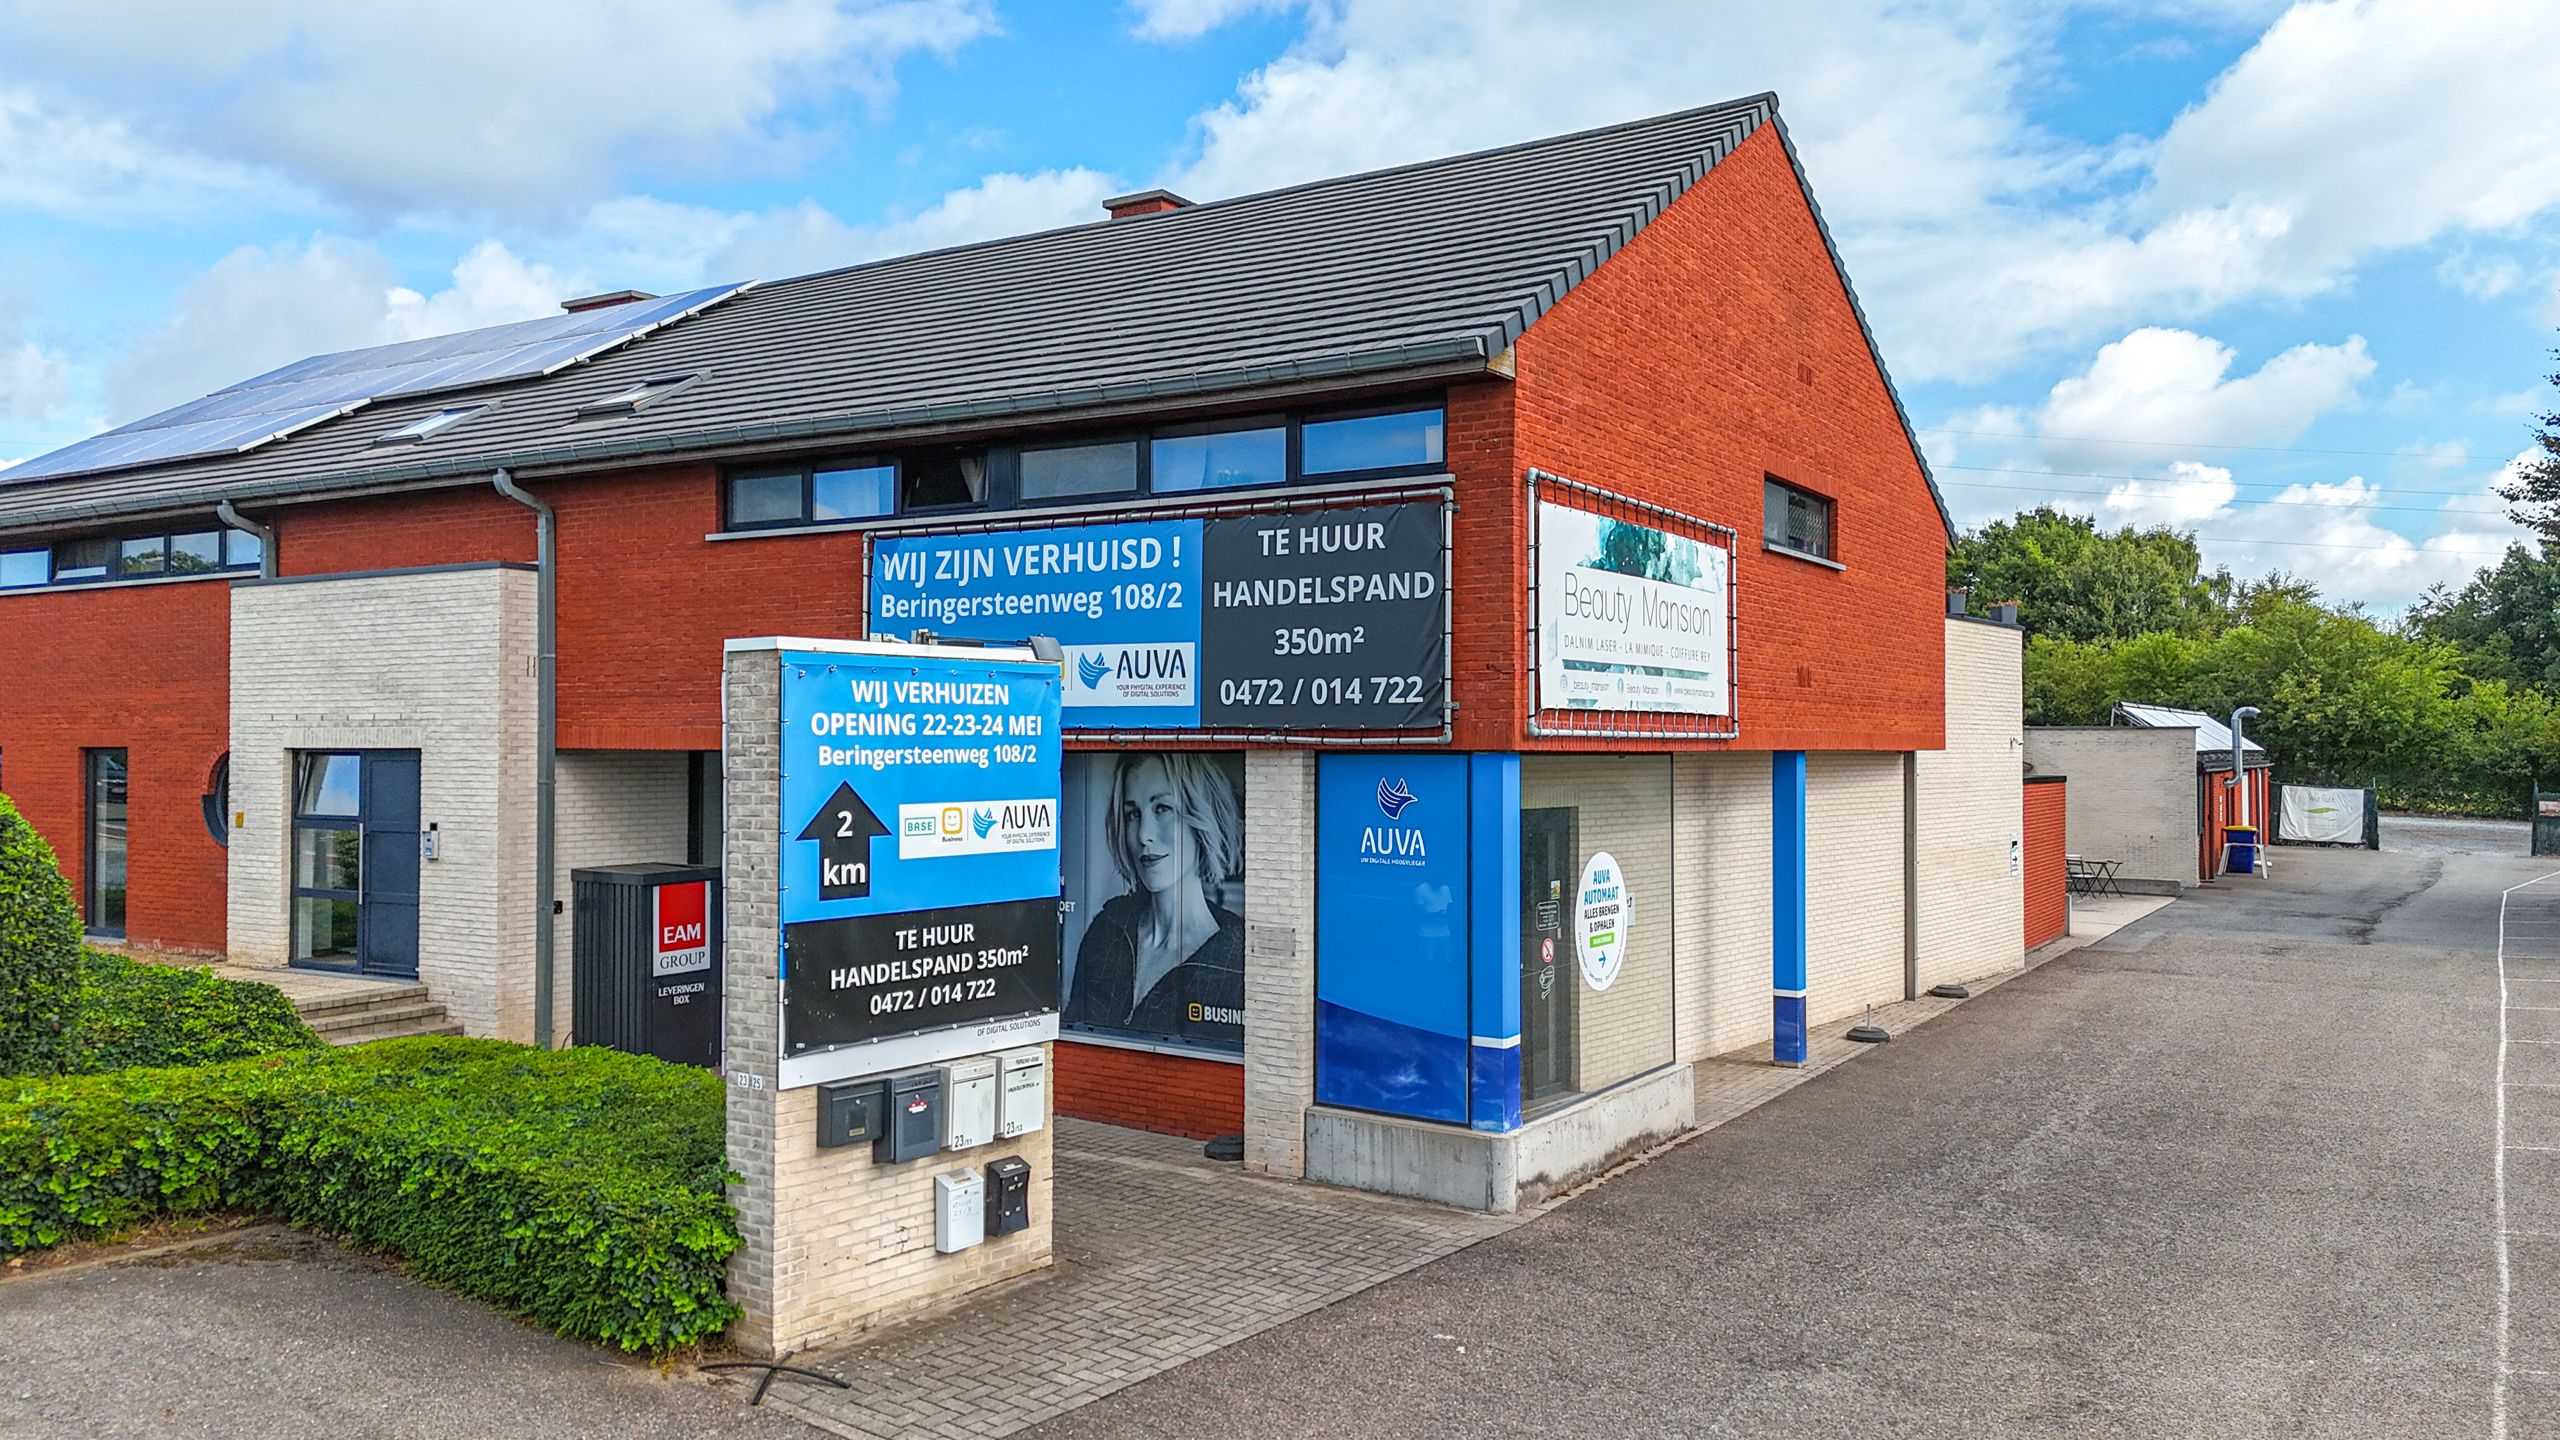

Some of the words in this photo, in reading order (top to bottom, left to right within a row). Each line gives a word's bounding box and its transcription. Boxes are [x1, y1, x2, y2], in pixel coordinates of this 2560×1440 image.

[1258, 529, 1290, 556] TE
[1299, 523, 1385, 553] HUUR
[883, 551, 928, 588] WIJ
[935, 549, 994, 583] ZIJN
[1004, 537, 1163, 576] VERHUISD
[1173, 536, 1181, 568] !
[881, 588, 1103, 623] Beringersteenweg
[1111, 582, 1184, 612] 108/2
[1214, 571, 1435, 608] HANDELSPAND
[1564, 572, 1632, 634] Beauty
[1642, 586, 1712, 637] Mansion
[1274, 626, 1364, 655] 350m²
[1564, 634, 1593, 650] DALNIM
[1596, 638, 1617, 653] LASER
[1624, 641, 1633, 654] LA
[1635, 642, 1664, 659] MIMIQUE
[1671, 646, 1699, 661] COIFFURE
[1116, 649, 1186, 679] AUVA
[852, 680, 888, 708] WIJ
[894, 681, 1010, 705] VERHUIZEN
[1220, 678, 1284, 706] 0472
[1291, 677, 1303, 707] /
[1312, 677, 1363, 704] 014
[1371, 676, 1424, 704] 722
[811, 712, 917, 736] OPENING
[922, 714, 1003, 736] 22-23-24
[1009, 715, 1042, 736] MEI
[818, 745, 989, 771] Beringersteenweg
[993, 744, 1037, 763] 108/2
[836, 810, 853, 837] 2
[908, 821, 933, 832] BASE
[1001, 804, 1050, 830] AUVA
[1361, 828, 1426, 856] AUVA
[823, 858, 866, 887] km
[1594, 870, 1610, 884] AUVA
[1584, 887, 1619, 904] AUTOMAAT
[1584, 907, 1598, 919] ALLES
[1599, 904, 1619, 917] BRENGEN
[1594, 919, 1615, 931] OPHALEN
[664, 922, 701, 945] EAM
[896, 928, 917, 950] TE
[922, 923, 974, 947] HUUR
[660, 951, 705, 970] GROUP
[830, 950, 974, 990] HANDELSPAND
[976, 945, 1029, 970] 350m²
[658, 982, 705, 997] LEVERINGEN
[673, 995, 690, 1005] BOX
[869, 990, 914, 1015] 0472
[918, 987, 927, 1009] /
[930, 984, 962, 1006] 014
[966, 979, 996, 1001] 722
[977, 1028, 985, 1036] OF
[986, 1024, 1008, 1036] DIGITAL
[1009, 1018, 1041, 1032] SOLUTIONS
[739, 1075, 747, 1086] 23
[753, 1077, 760, 1089] 25
